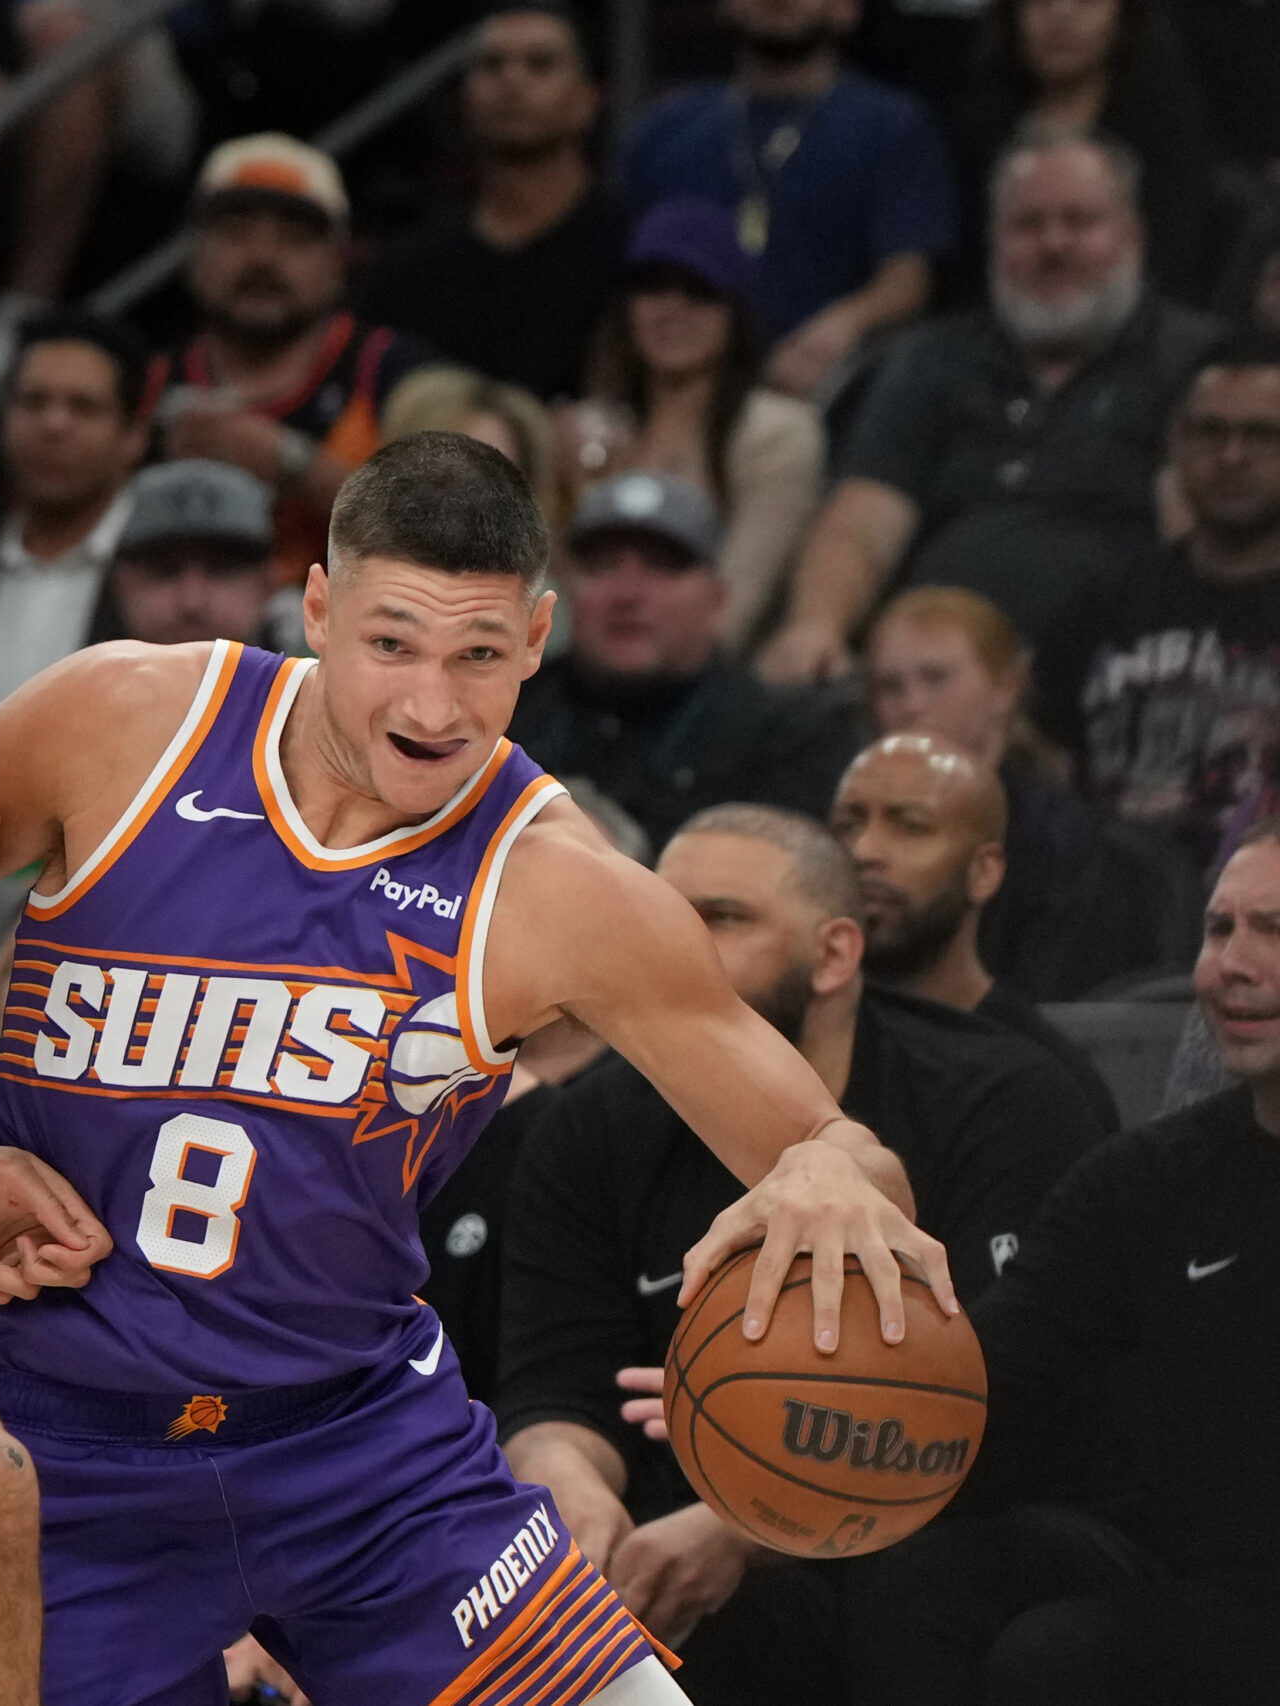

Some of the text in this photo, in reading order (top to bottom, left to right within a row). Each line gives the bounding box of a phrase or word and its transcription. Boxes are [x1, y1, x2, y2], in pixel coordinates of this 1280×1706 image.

[369, 867, 463, 920] PayPal
[33, 960, 386, 1103] SUNS
[136, 1113, 257, 1280] 8
[782, 1397, 970, 1477] Wilson
[451, 1502, 559, 1649] PHOENIX
